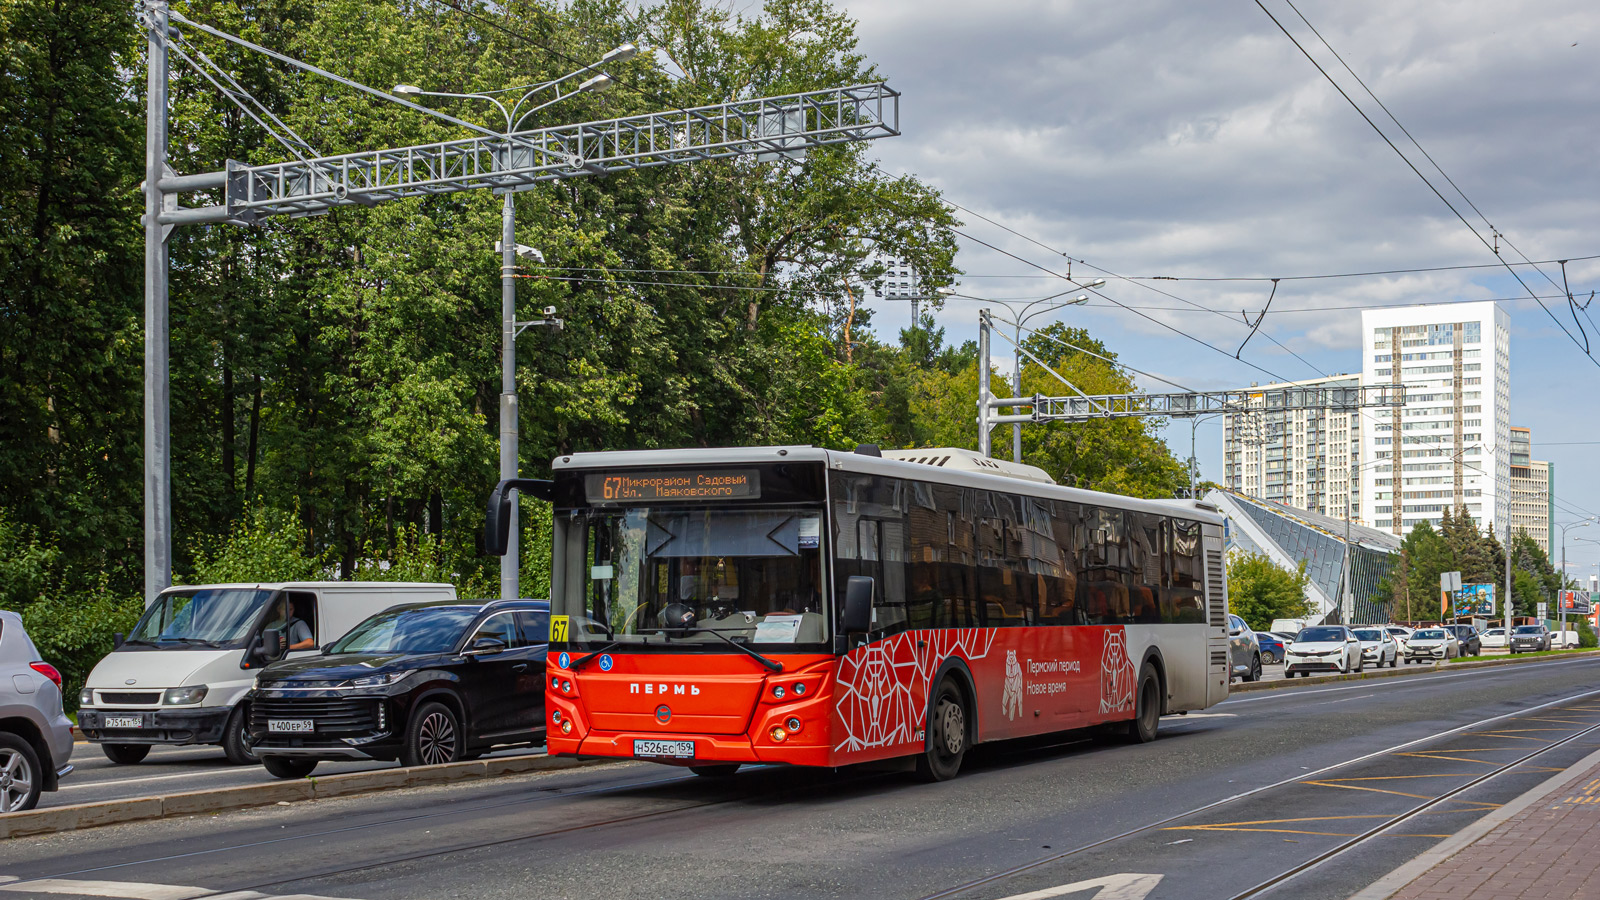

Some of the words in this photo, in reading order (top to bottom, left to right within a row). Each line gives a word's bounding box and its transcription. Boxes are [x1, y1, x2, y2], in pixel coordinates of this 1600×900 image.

[603, 477, 621, 499] 67
[622, 476, 691, 488] Микрорайон
[697, 475, 747, 486] Садовый
[656, 486, 733, 497] Маяковского
[552, 620, 567, 642] 67
[1027, 658, 1057, 676] Пермский
[1059, 660, 1080, 676] период
[630, 683, 700, 695] ПЕРМЬ
[1027, 680, 1047, 695] Новое
[1048, 682, 1067, 696] время
